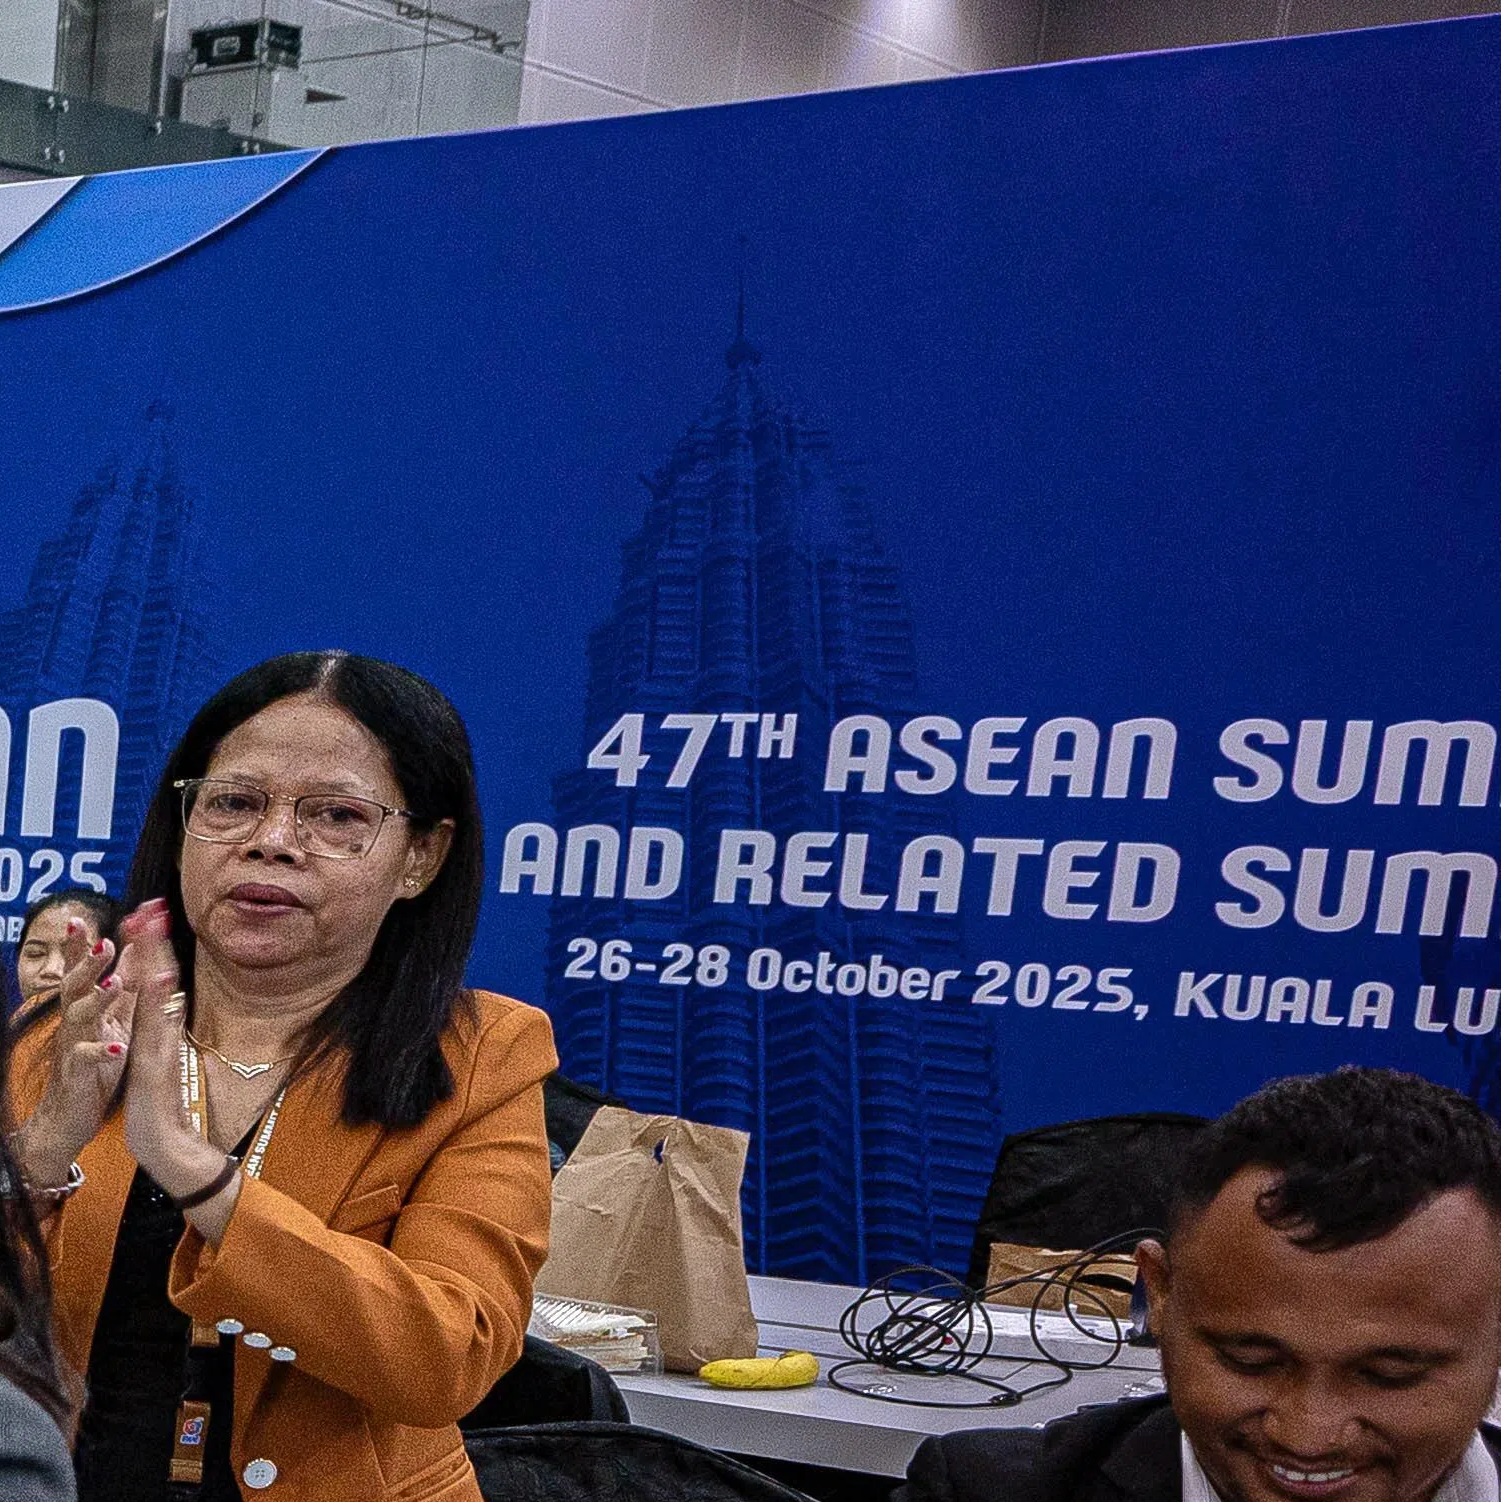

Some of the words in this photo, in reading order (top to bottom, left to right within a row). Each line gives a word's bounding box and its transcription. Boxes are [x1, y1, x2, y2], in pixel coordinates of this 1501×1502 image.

[587, 713, 798, 788] 47TH
[823, 713, 1178, 800] ASEAN
[499, 822, 684, 900] AND
[712, 828, 1182, 923] RELATED
[563, 937, 731, 986] 26-28
[746, 947, 962, 1002] October
[972, 960, 1150, 1021] 2025,
[1173, 971, 1395, 1030] KUALA
[255, 1108, 278, 1154] SUMMIT
